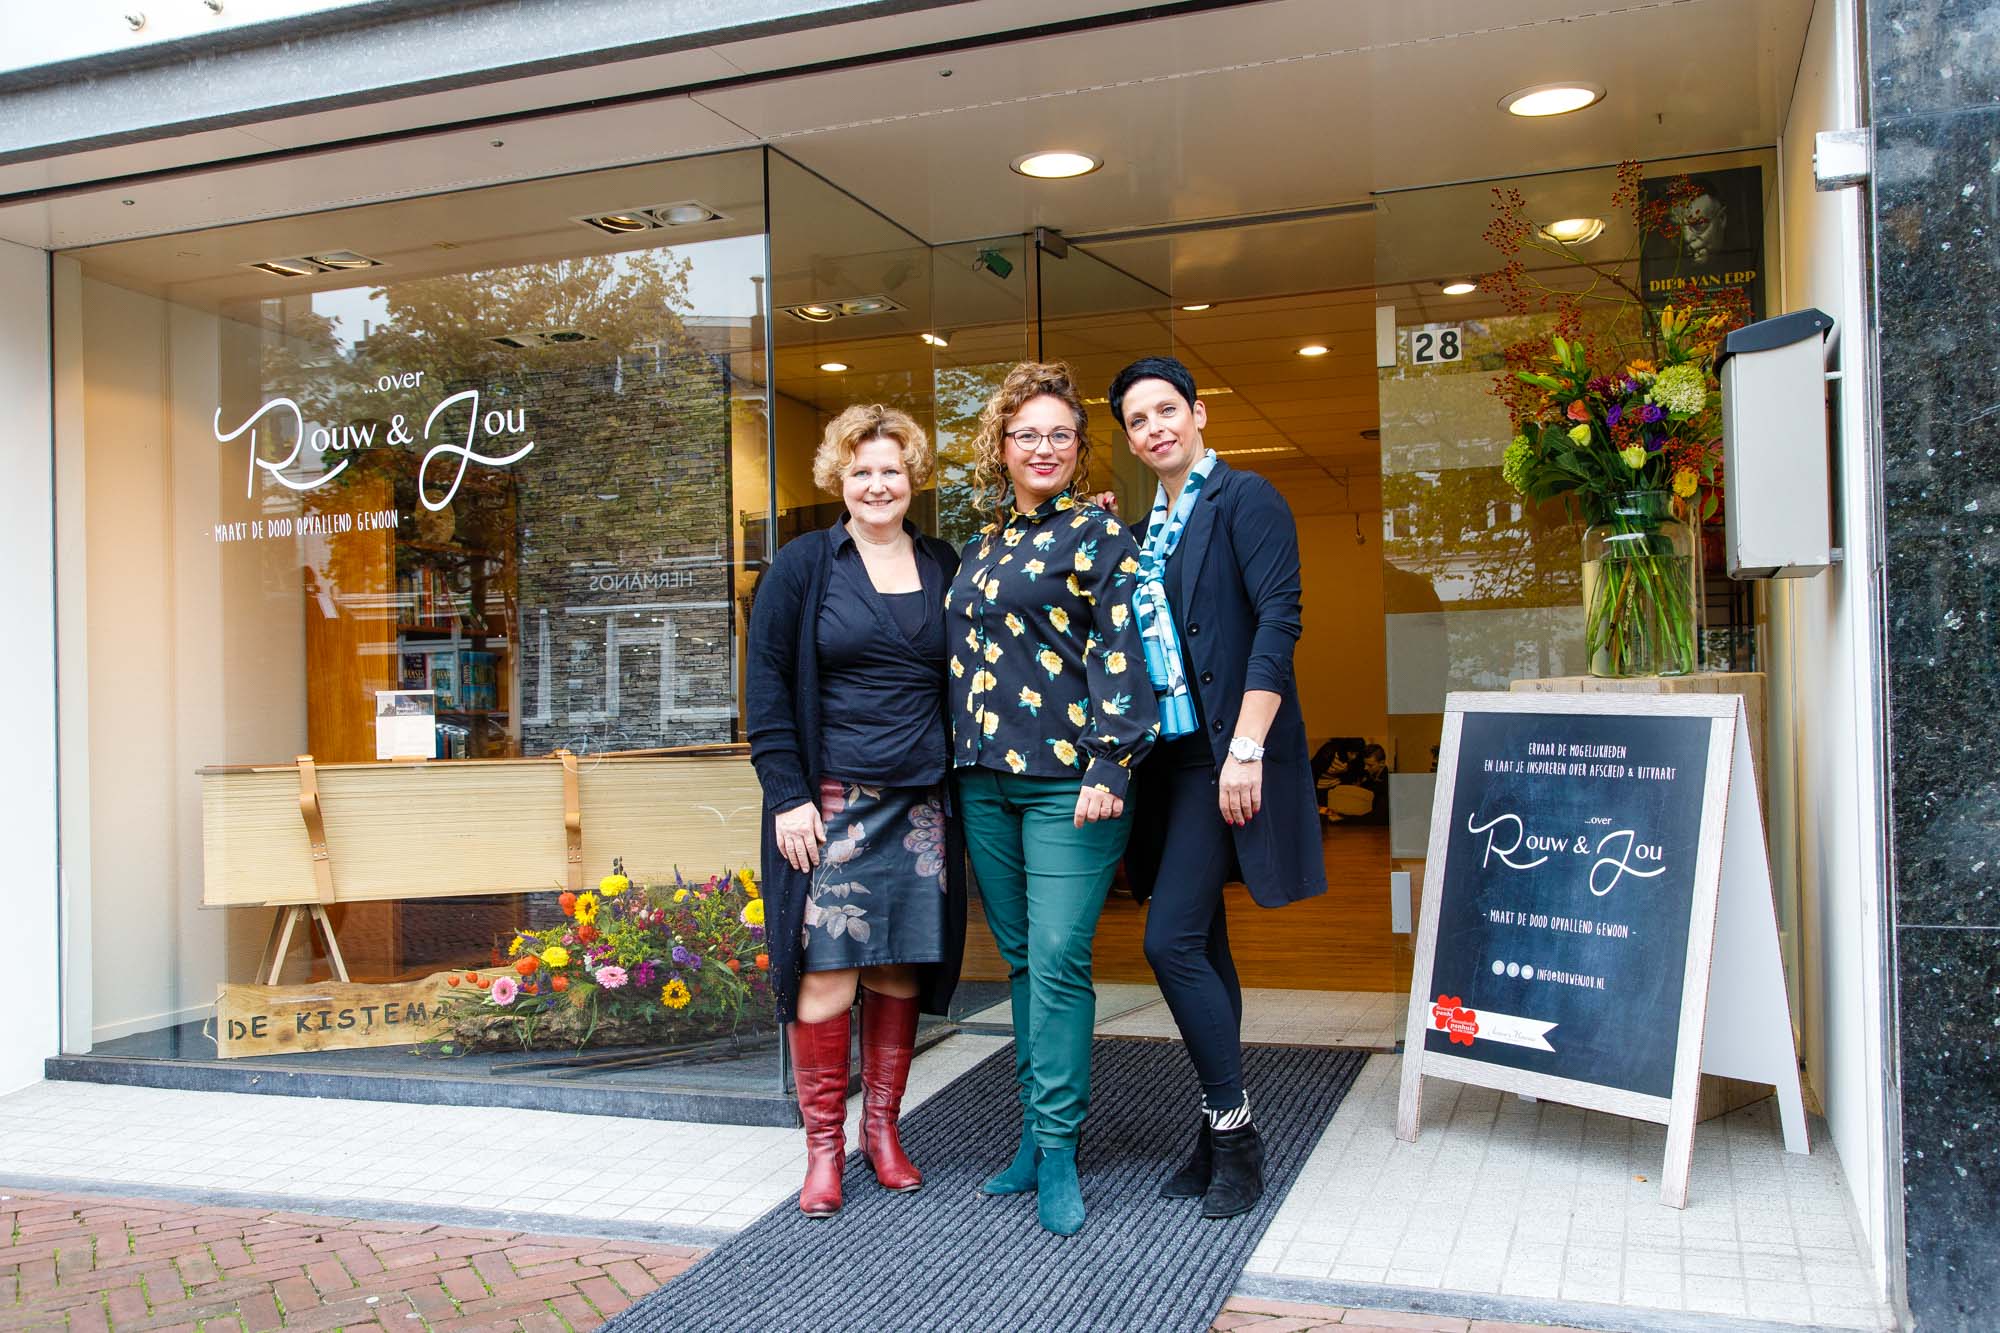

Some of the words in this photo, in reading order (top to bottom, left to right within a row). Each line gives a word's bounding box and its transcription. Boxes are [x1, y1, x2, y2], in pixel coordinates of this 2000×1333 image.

[1689, 274, 1721, 287] VAN
[1724, 270, 1757, 285] ERP
[1415, 330, 1460, 362] 28
[213, 397, 377, 499] Rouw
[386, 413, 414, 446] &
[214, 521, 248, 543] MAAKT
[251, 520, 264, 540] DE
[268, 517, 293, 539] DOOD
[296, 512, 352, 536] OPVALLEND
[357, 509, 399, 531] GEWOON
[1528, 742, 1555, 756] ERVAAR
[1557, 743, 1567, 757] DE
[1569, 744, 1627, 759] MOGELIJKHEDEN
[1484, 759, 1493, 772] EN
[1495, 760, 1514, 773] LAAT
[1515, 761, 1524, 774] JE
[1526, 762, 1567, 776] INSPIREREN
[1568, 762, 1587, 777] OVER
[1589, 764, 1625, 778] AFSCHEID
[1627, 767, 1634, 777] &
[1637, 766, 1677, 781] UITVAART
[1468, 812, 1569, 870] Rouw
[1573, 835, 1591, 855] &
[1489, 909, 1515, 925] MAAKT
[1517, 912, 1527, 926] DE
[1529, 913, 1548, 929] DOOD
[1550, 916, 1593, 935] OPVALLEND
[1596, 922, 1629, 939] GEWOON
[227, 1015, 268, 1041] DE
